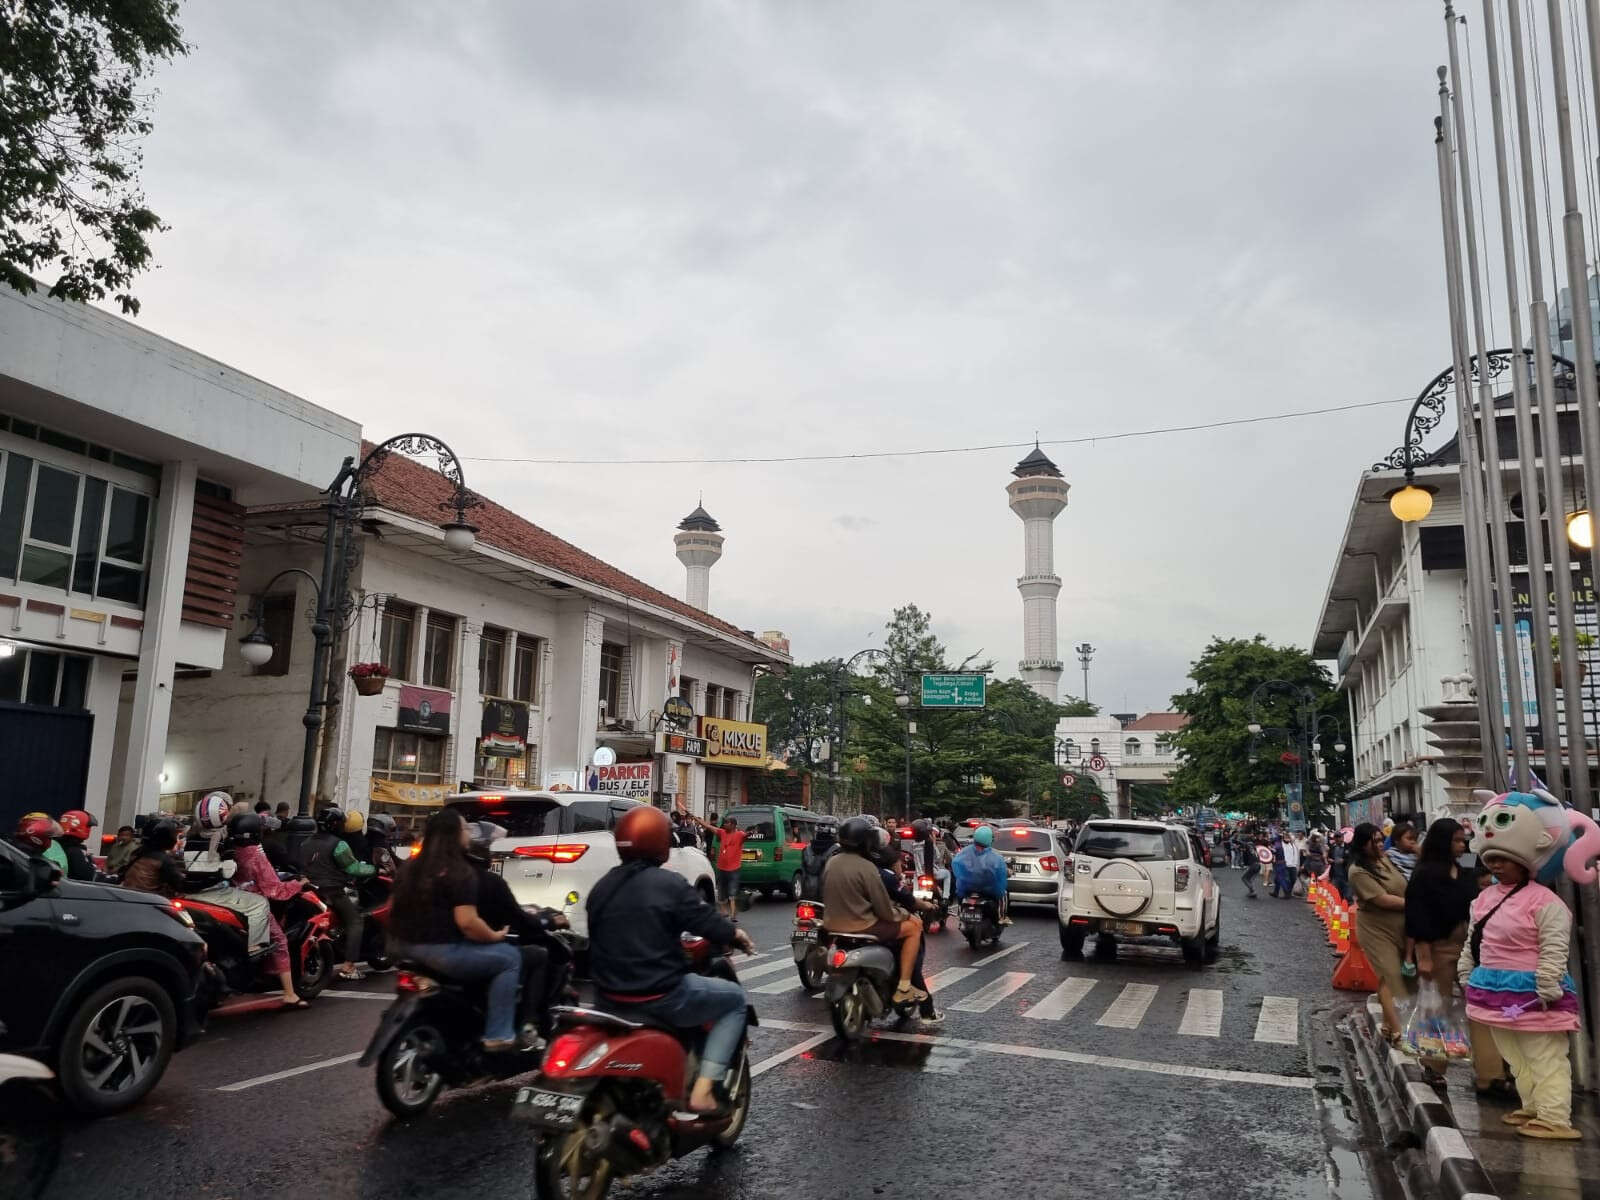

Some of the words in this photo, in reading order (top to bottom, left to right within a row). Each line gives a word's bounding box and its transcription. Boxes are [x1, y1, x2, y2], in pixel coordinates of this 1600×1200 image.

[723, 730, 761, 752] MIXUE
[599, 766, 650, 780] PARKIR
[631, 781, 649, 789] ELF
